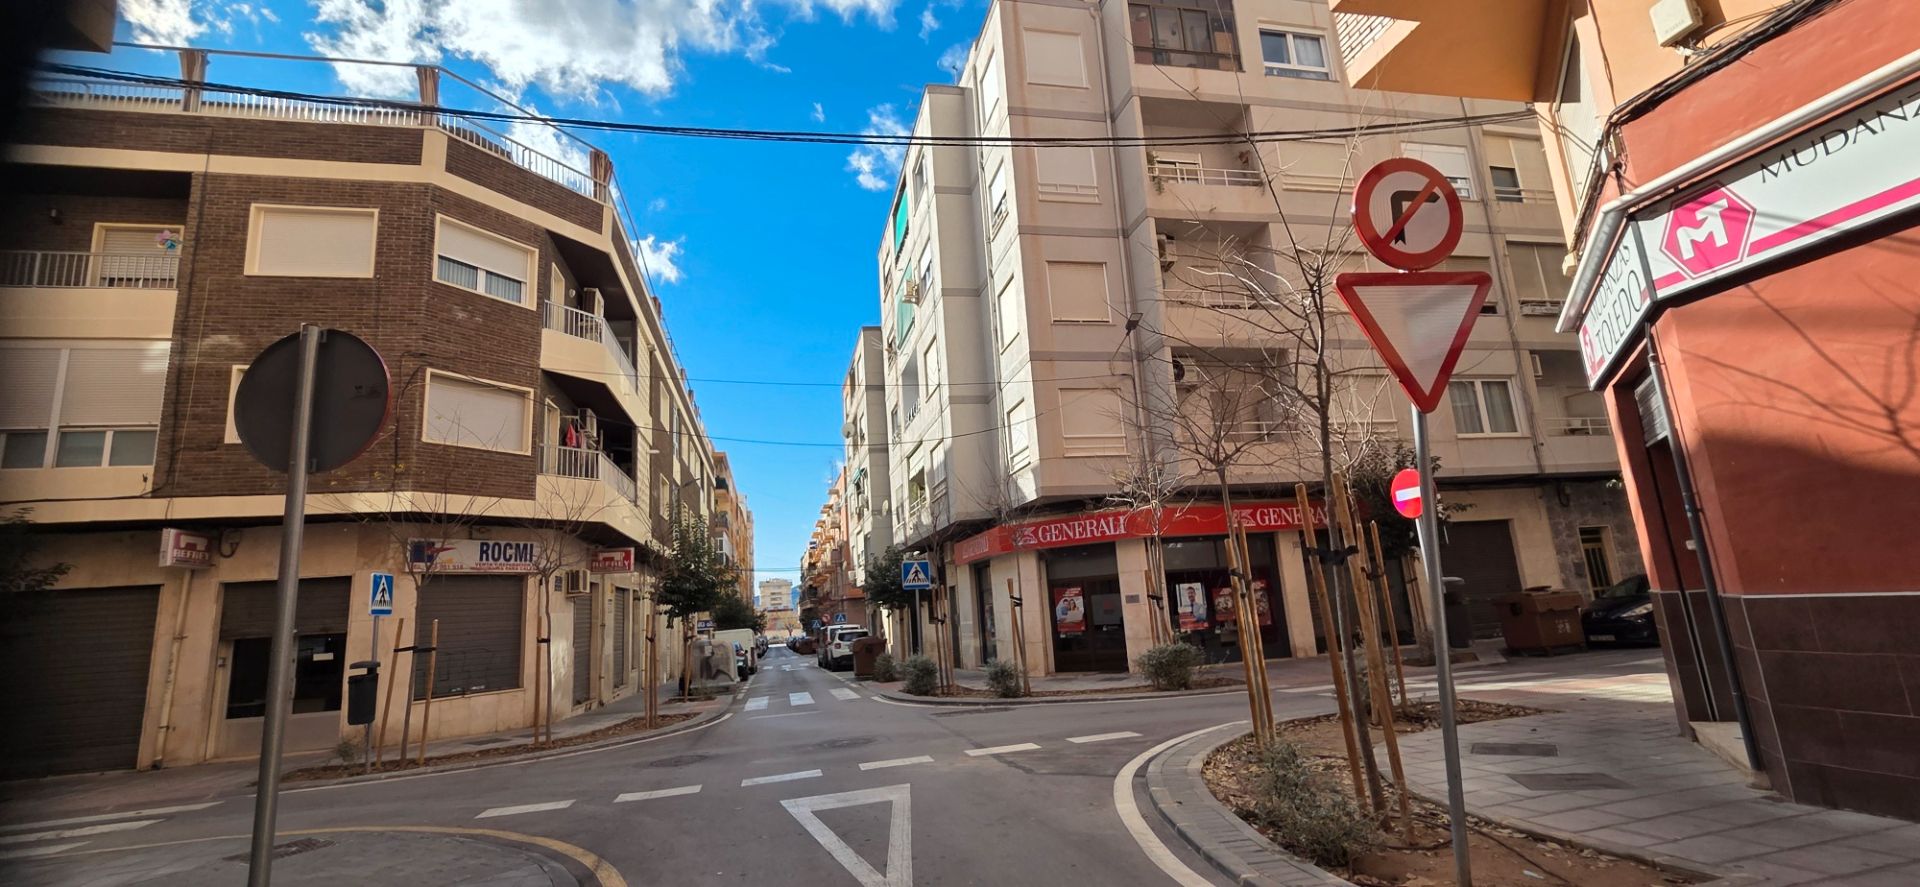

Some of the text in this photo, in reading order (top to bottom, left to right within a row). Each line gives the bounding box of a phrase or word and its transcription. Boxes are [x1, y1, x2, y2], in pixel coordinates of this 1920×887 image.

[1595, 269, 1643, 355] TOLEDO
[1256, 506, 1330, 526] GENERA
[1038, 515, 1127, 544] GENERALI
[479, 541, 534, 563] ROCMI
